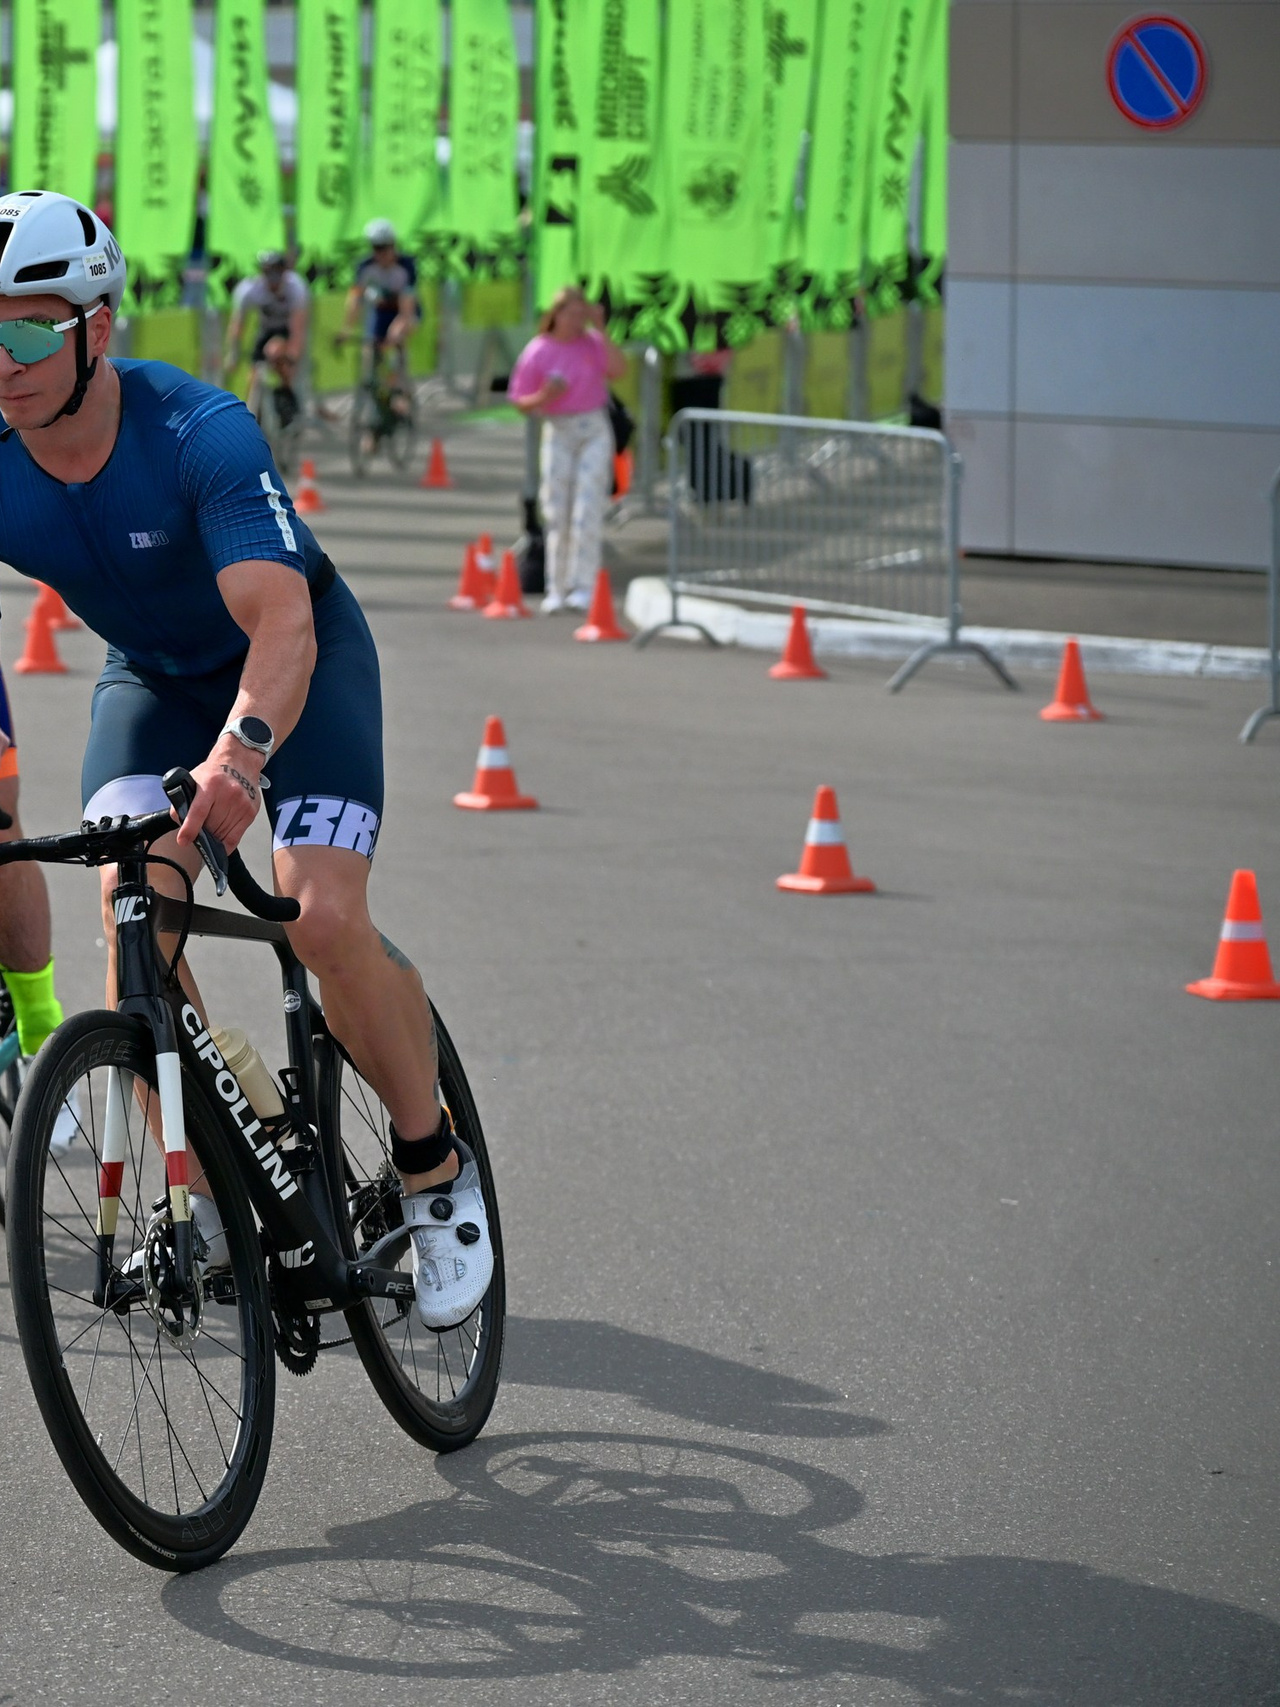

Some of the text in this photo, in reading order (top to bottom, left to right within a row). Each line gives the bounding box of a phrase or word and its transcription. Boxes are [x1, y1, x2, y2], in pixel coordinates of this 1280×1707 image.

[89, 263, 107, 276] 1085
[220, 764, 257, 800] 1085
[181, 1003, 299, 1201] CIPOLLINI
[127, 1522, 177, 1561] CONTINENTAL
